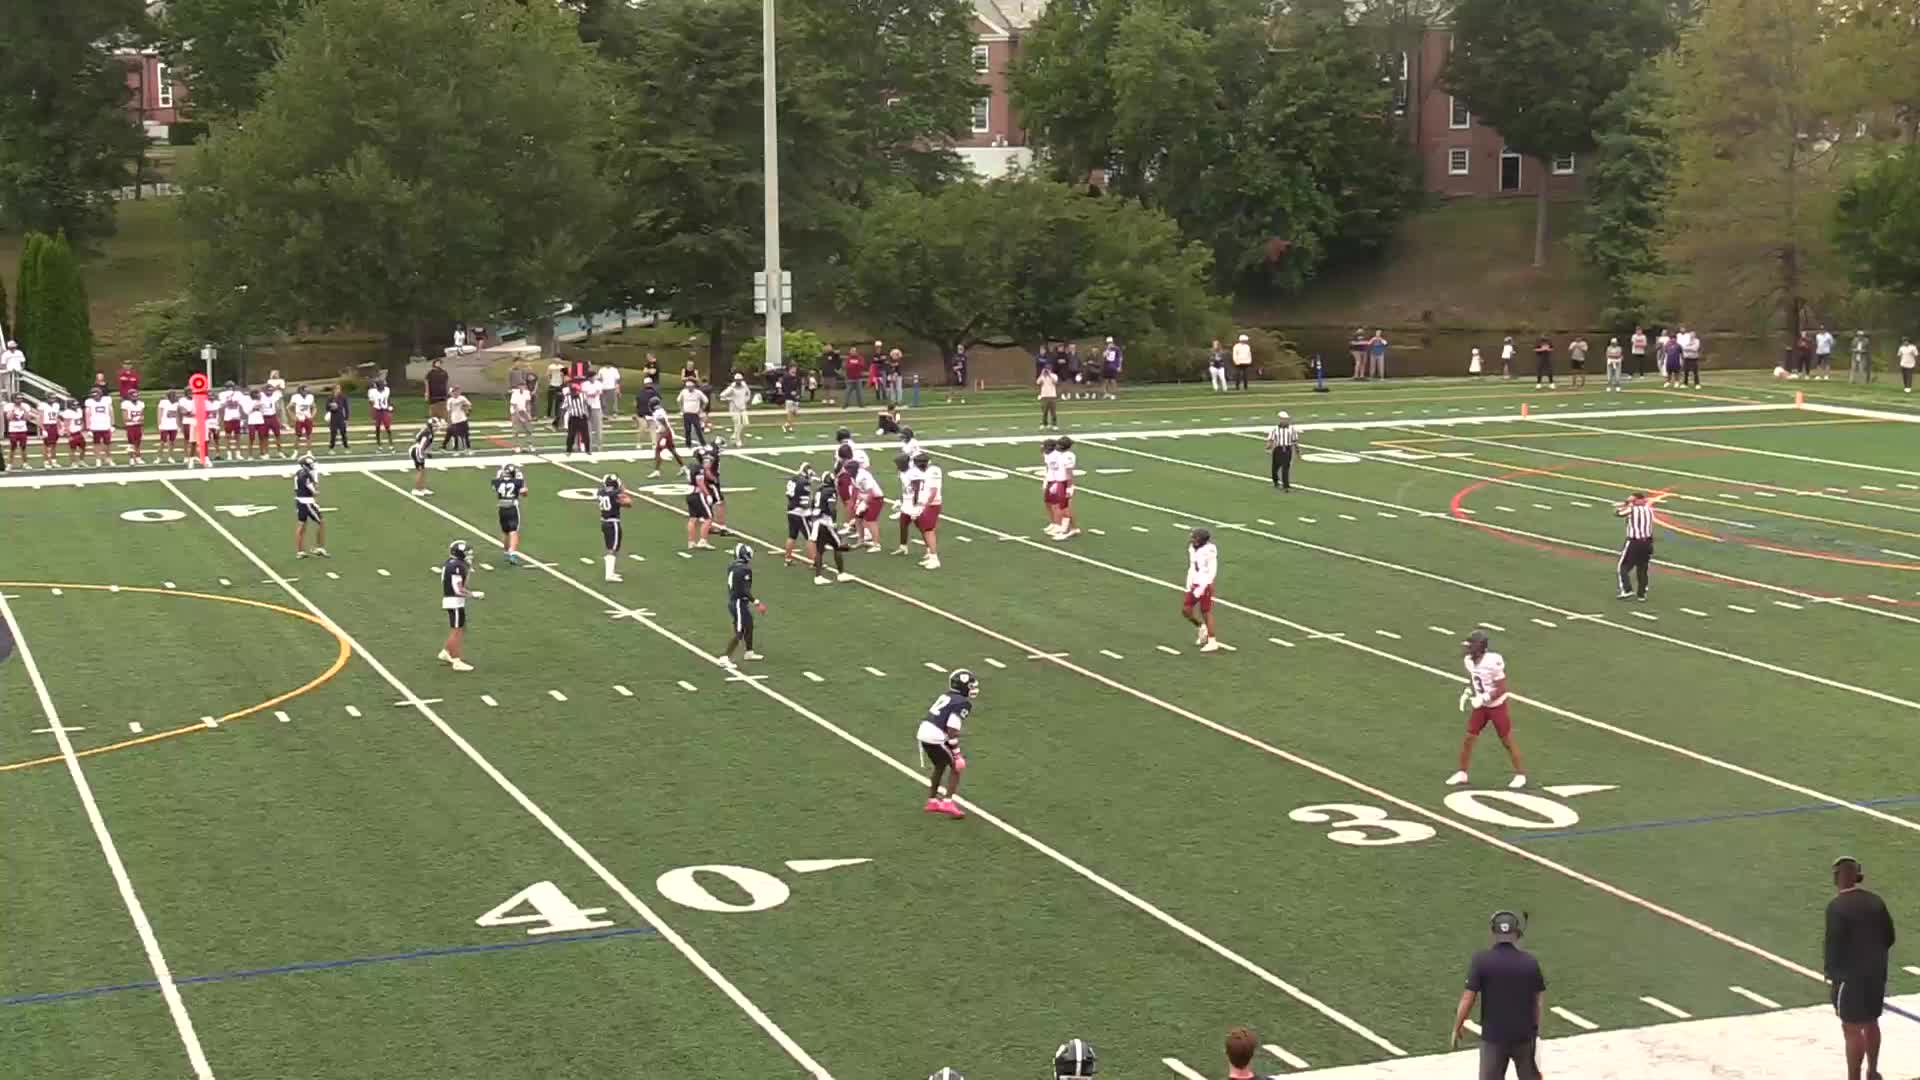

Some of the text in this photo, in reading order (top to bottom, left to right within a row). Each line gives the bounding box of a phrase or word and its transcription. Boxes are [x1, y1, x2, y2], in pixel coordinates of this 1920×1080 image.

[497, 482, 516, 498] 42
[598, 495, 612, 511] 20
[929, 694, 952, 716] 2
